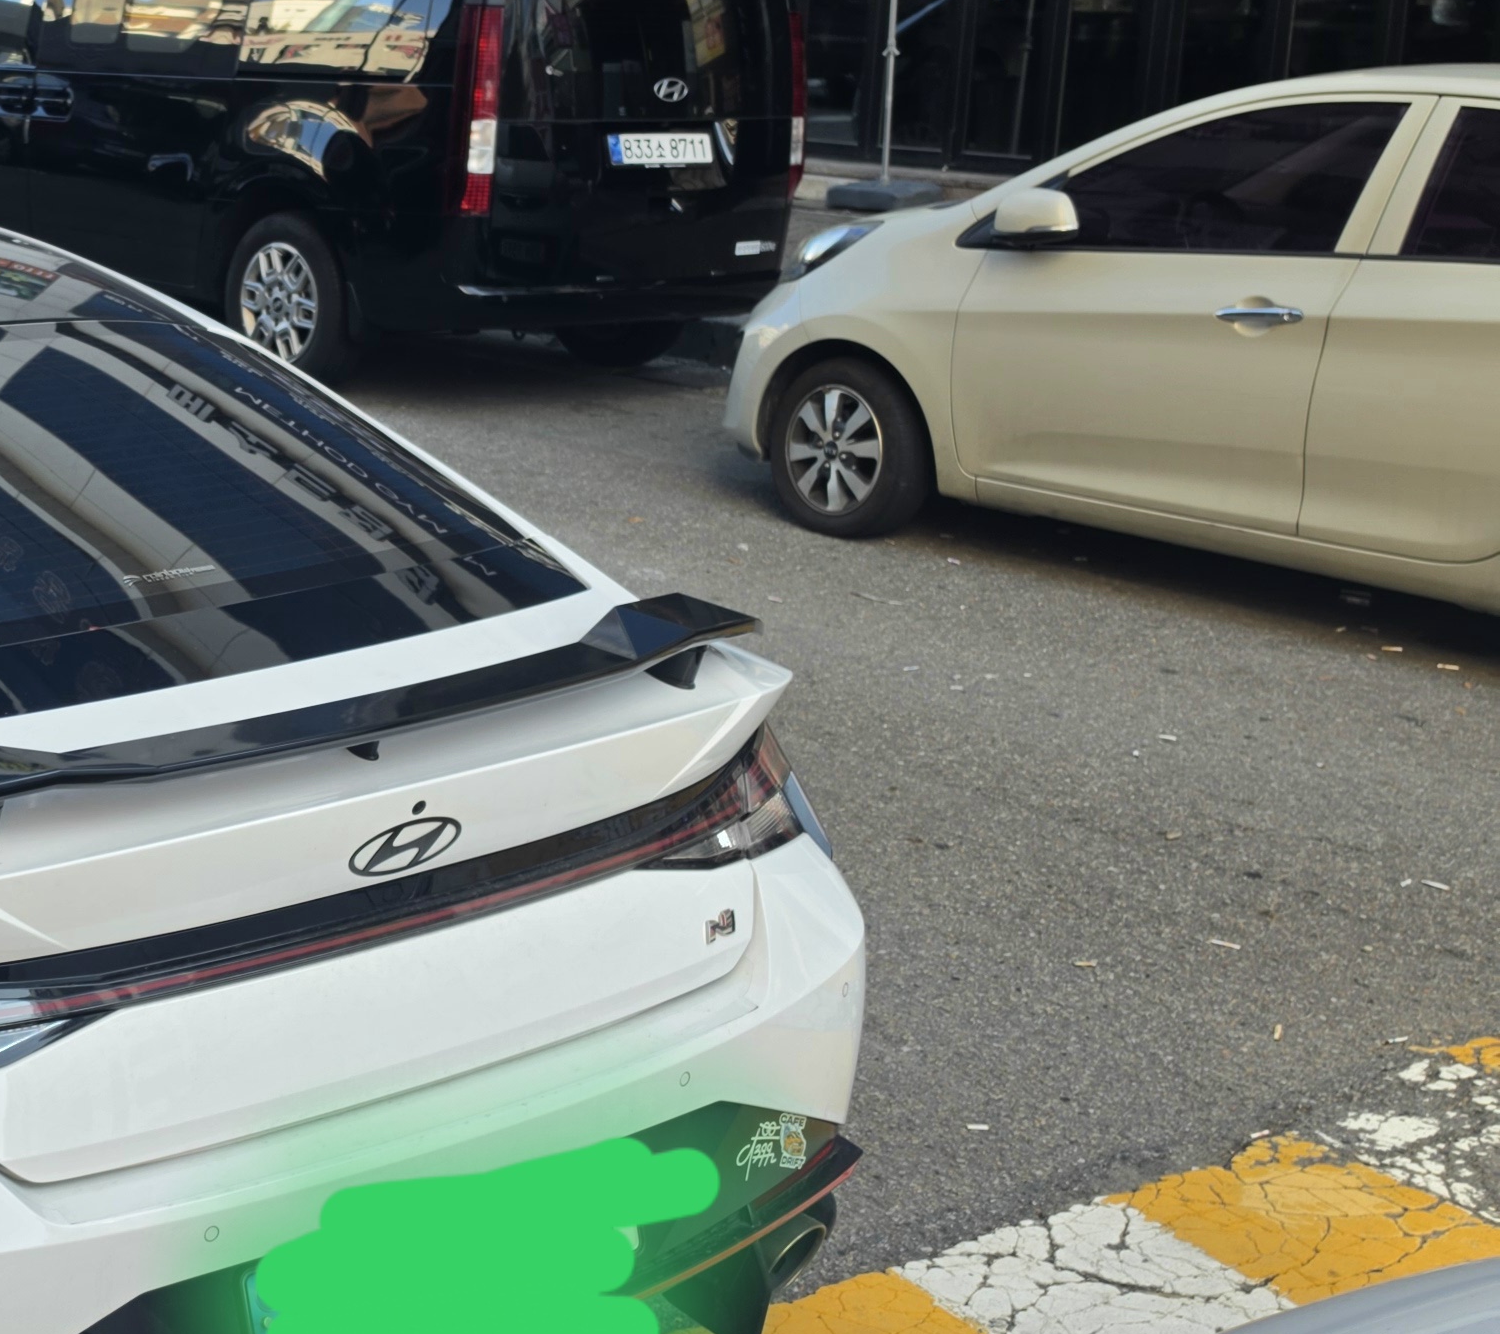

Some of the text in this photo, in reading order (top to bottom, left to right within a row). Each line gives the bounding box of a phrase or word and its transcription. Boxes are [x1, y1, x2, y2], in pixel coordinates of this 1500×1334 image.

[669, 138, 708, 160] 8711
[780, 1113, 807, 1128] CAFE
[780, 1155, 806, 1169] DRIFT
